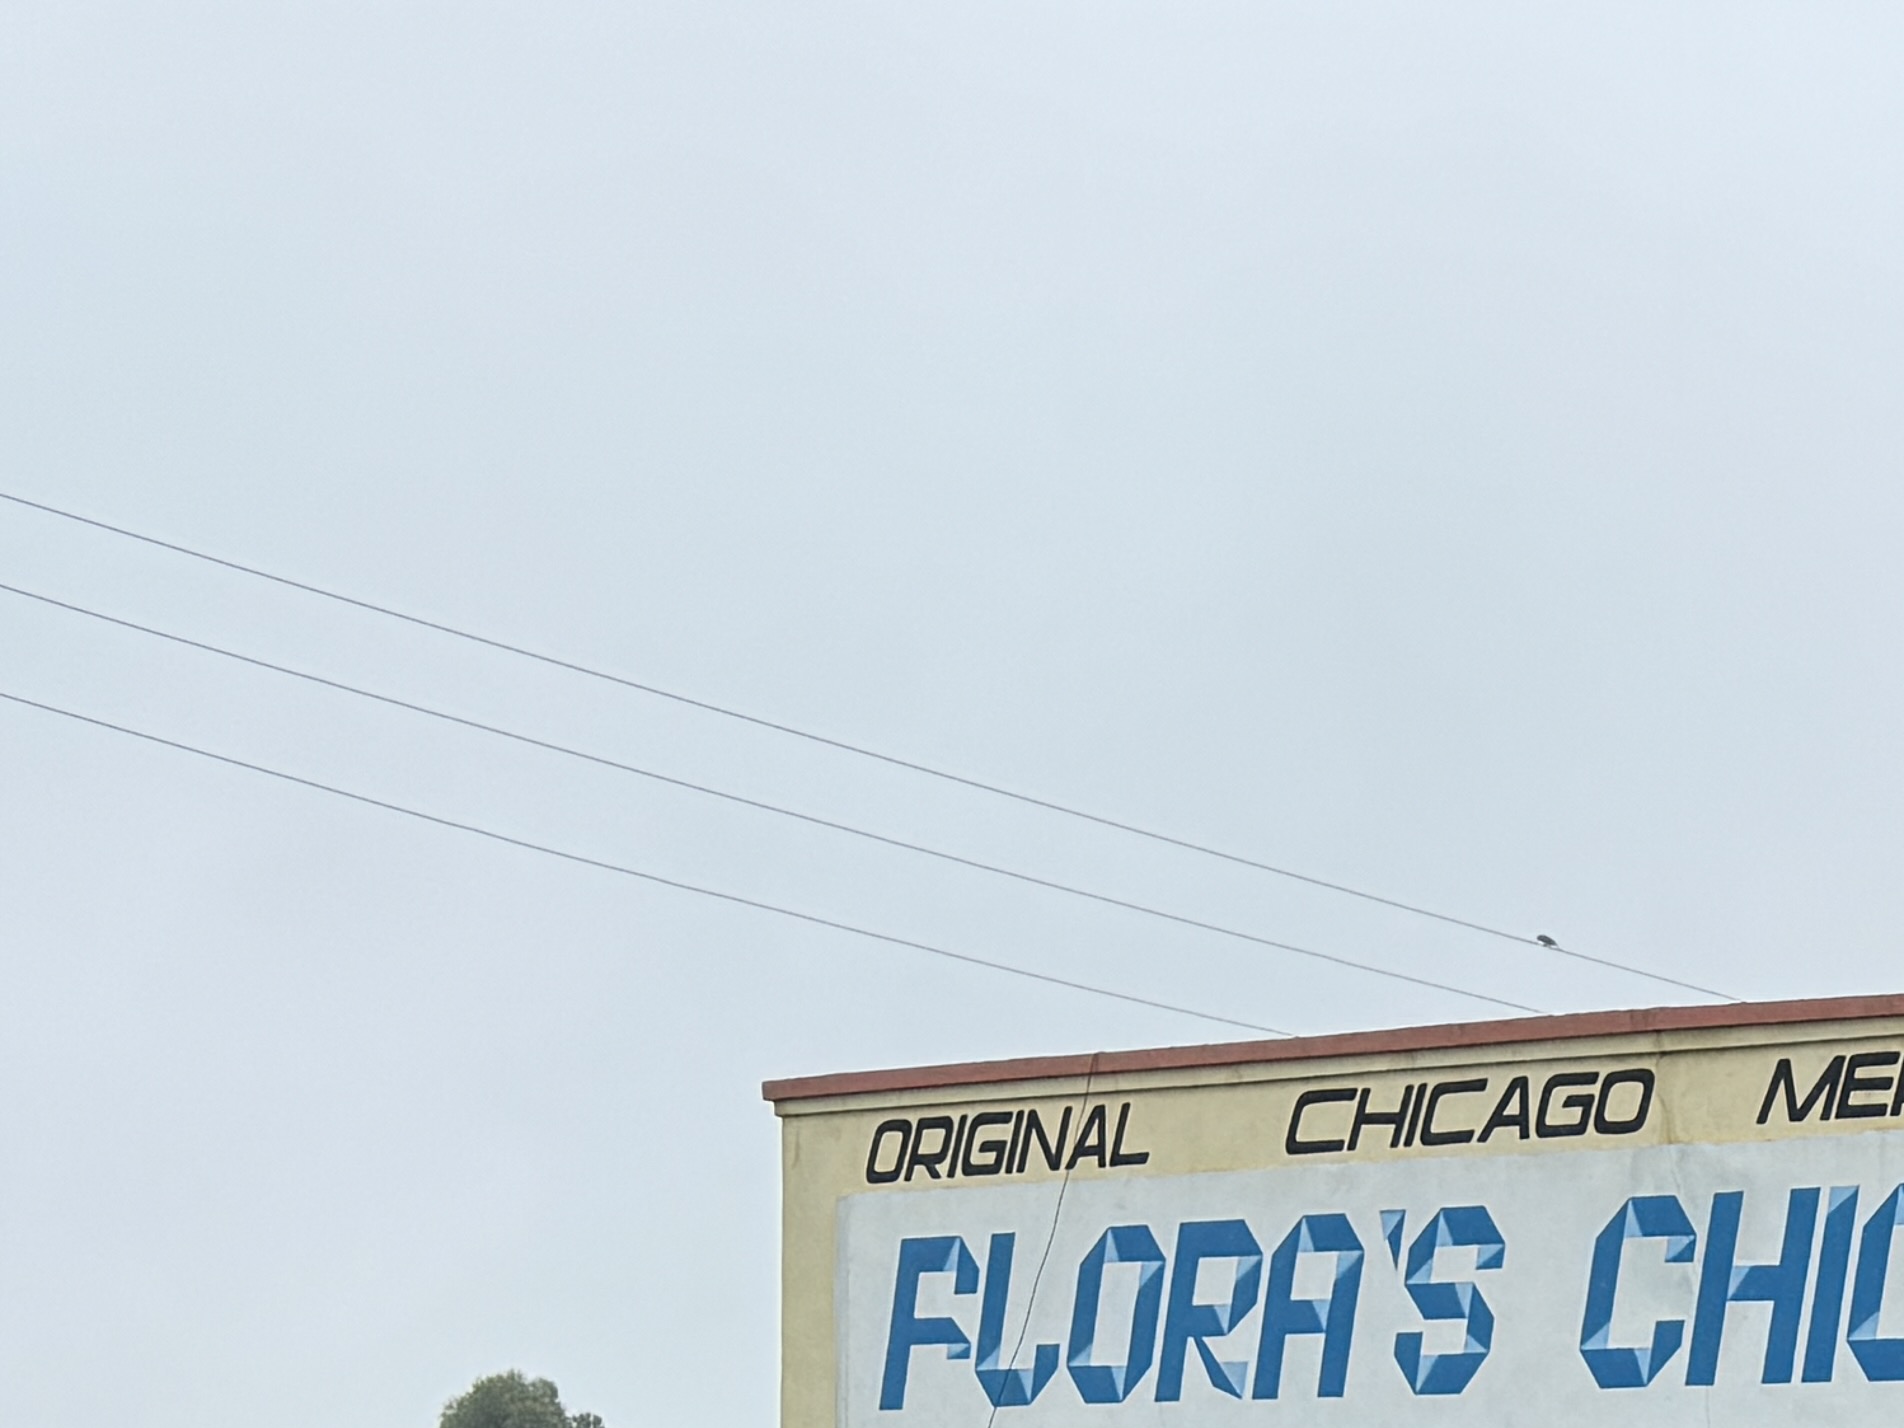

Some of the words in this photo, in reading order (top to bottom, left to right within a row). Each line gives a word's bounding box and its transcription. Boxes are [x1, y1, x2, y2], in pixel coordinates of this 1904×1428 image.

[867, 1103, 1149, 1183] ORIGINAL
[1286, 1069, 1655, 1154] CHICAGO
[880, 1206, 1506, 1411] FLORA'S
